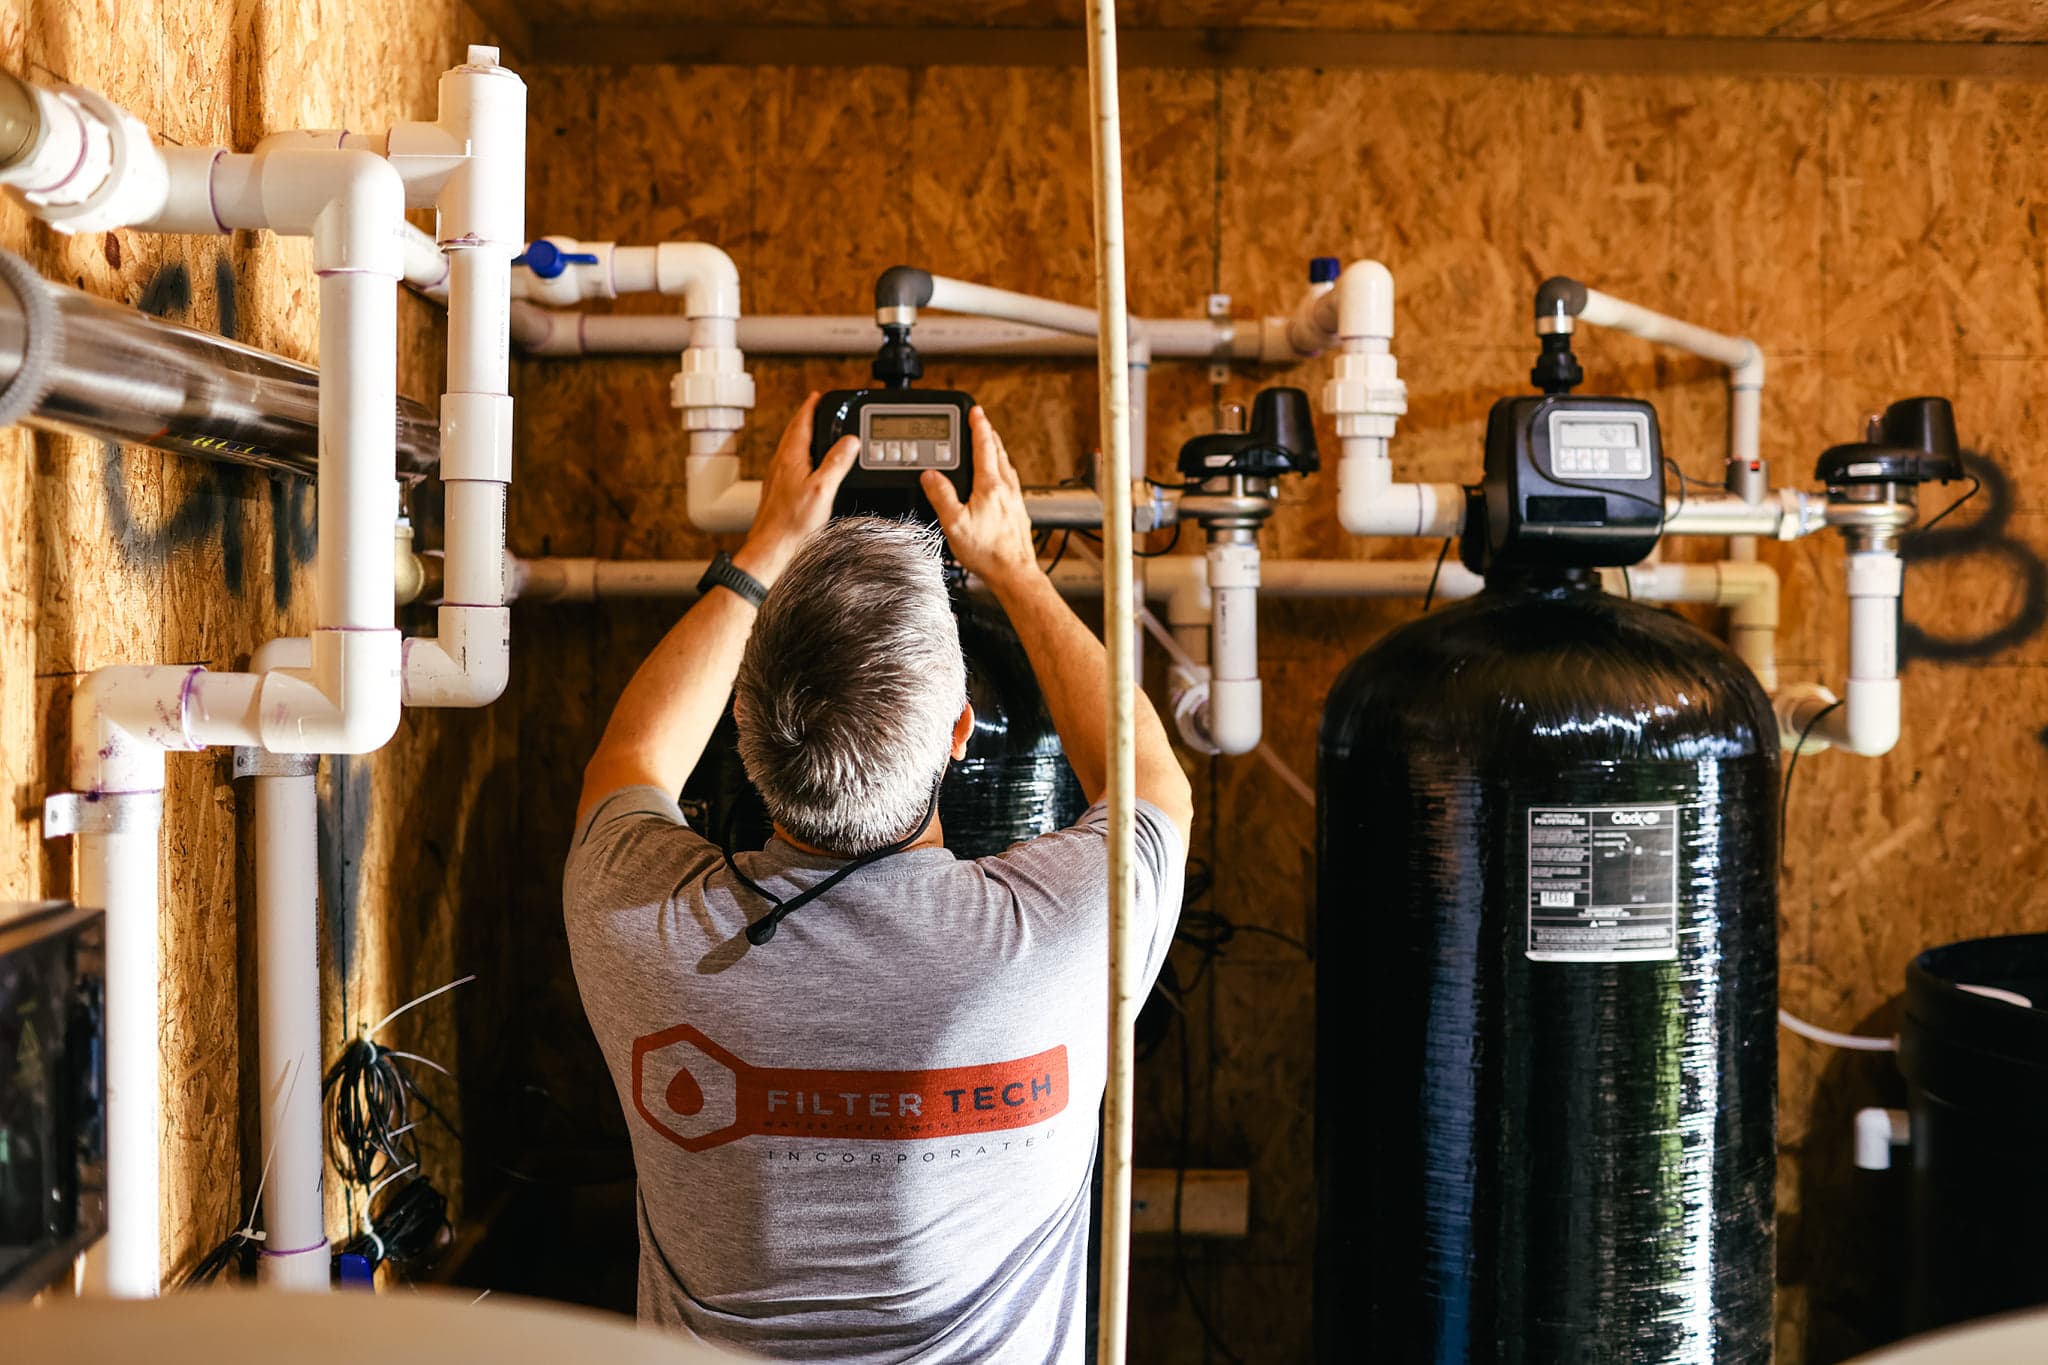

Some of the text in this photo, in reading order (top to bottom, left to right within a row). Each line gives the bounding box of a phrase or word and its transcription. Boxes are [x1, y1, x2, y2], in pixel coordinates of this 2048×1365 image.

[767, 1073, 1052, 1118] FILTER TECH
[768, 1129, 1056, 1164] INCORPORATED
